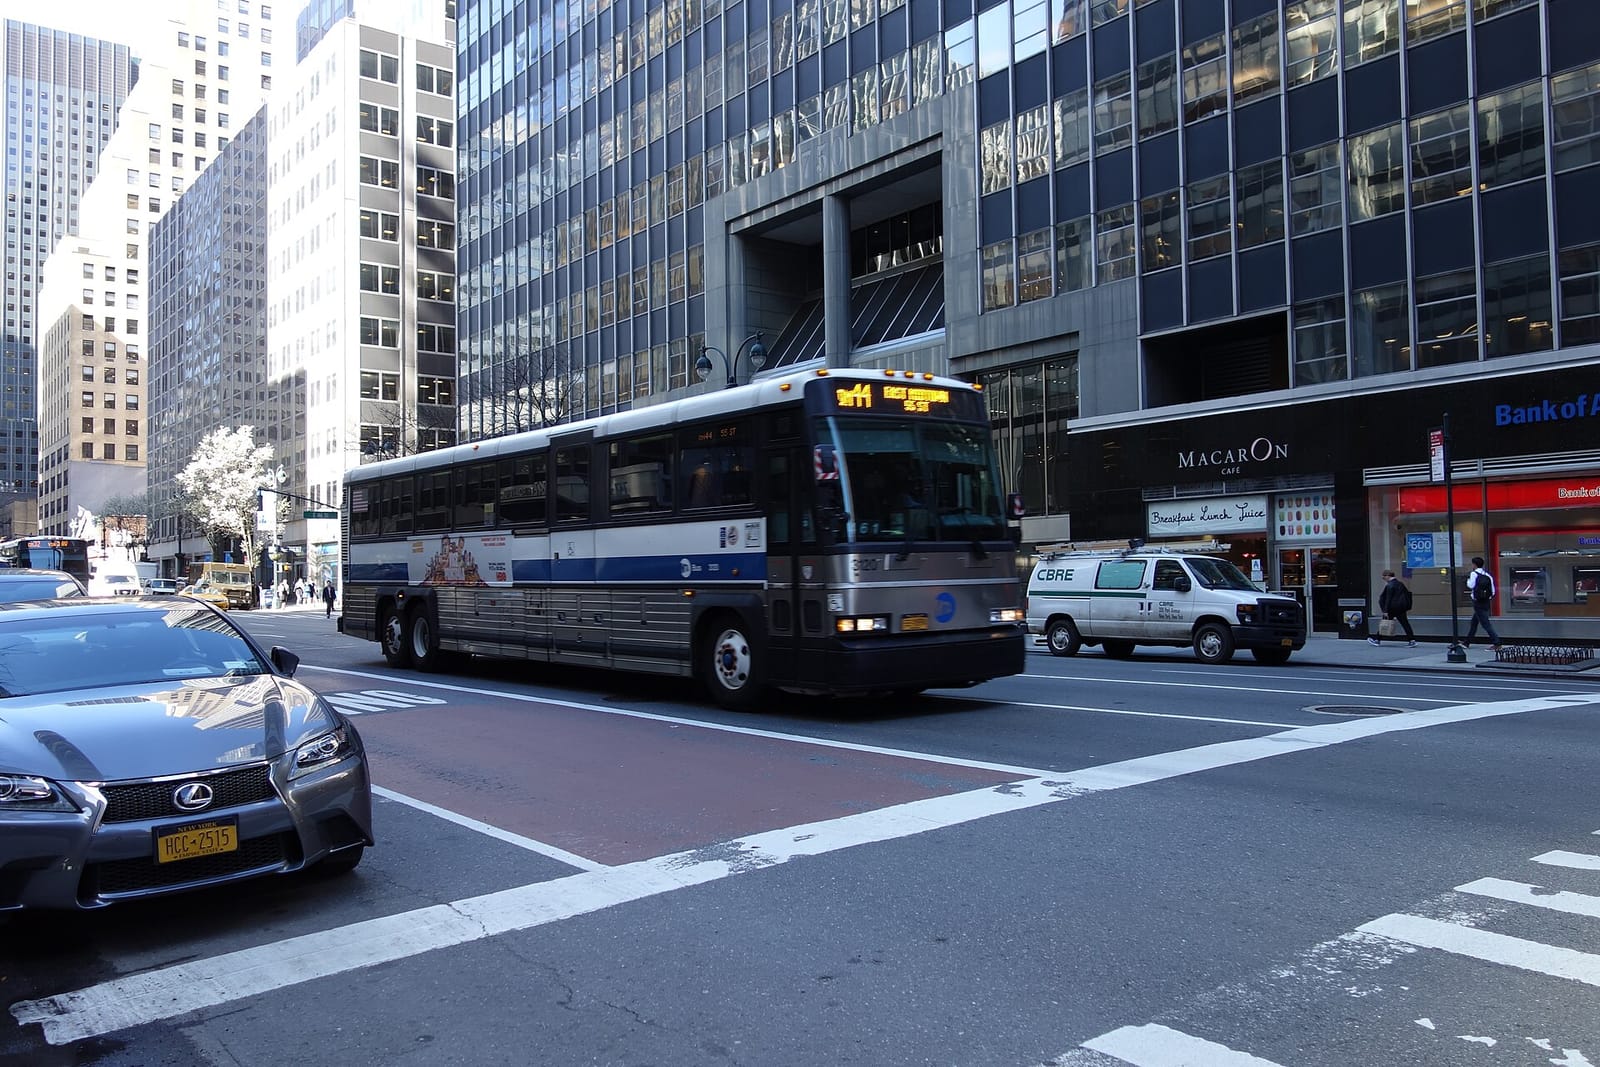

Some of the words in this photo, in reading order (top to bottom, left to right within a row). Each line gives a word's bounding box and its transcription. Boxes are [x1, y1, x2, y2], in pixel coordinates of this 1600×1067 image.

[801, 136, 843, 180] 750
[1495, 400, 1558, 426] Bank
[1560, 393, 1587, 420] of
[1221, 466, 1240, 475] CAFÉ
[1558, 486, 1588, 498] Bank
[1151, 511, 1195, 526] Breakfast
[1200, 505, 1232, 521] Lunch
[1236, 502, 1266, 521] Juice
[1037, 569, 1074, 581] CBRE
[177, 825, 197, 833] NEW
[198, 821, 217, 830] YORK
[165, 835, 189, 856] HCC
[198, 827, 229, 850] 2515
